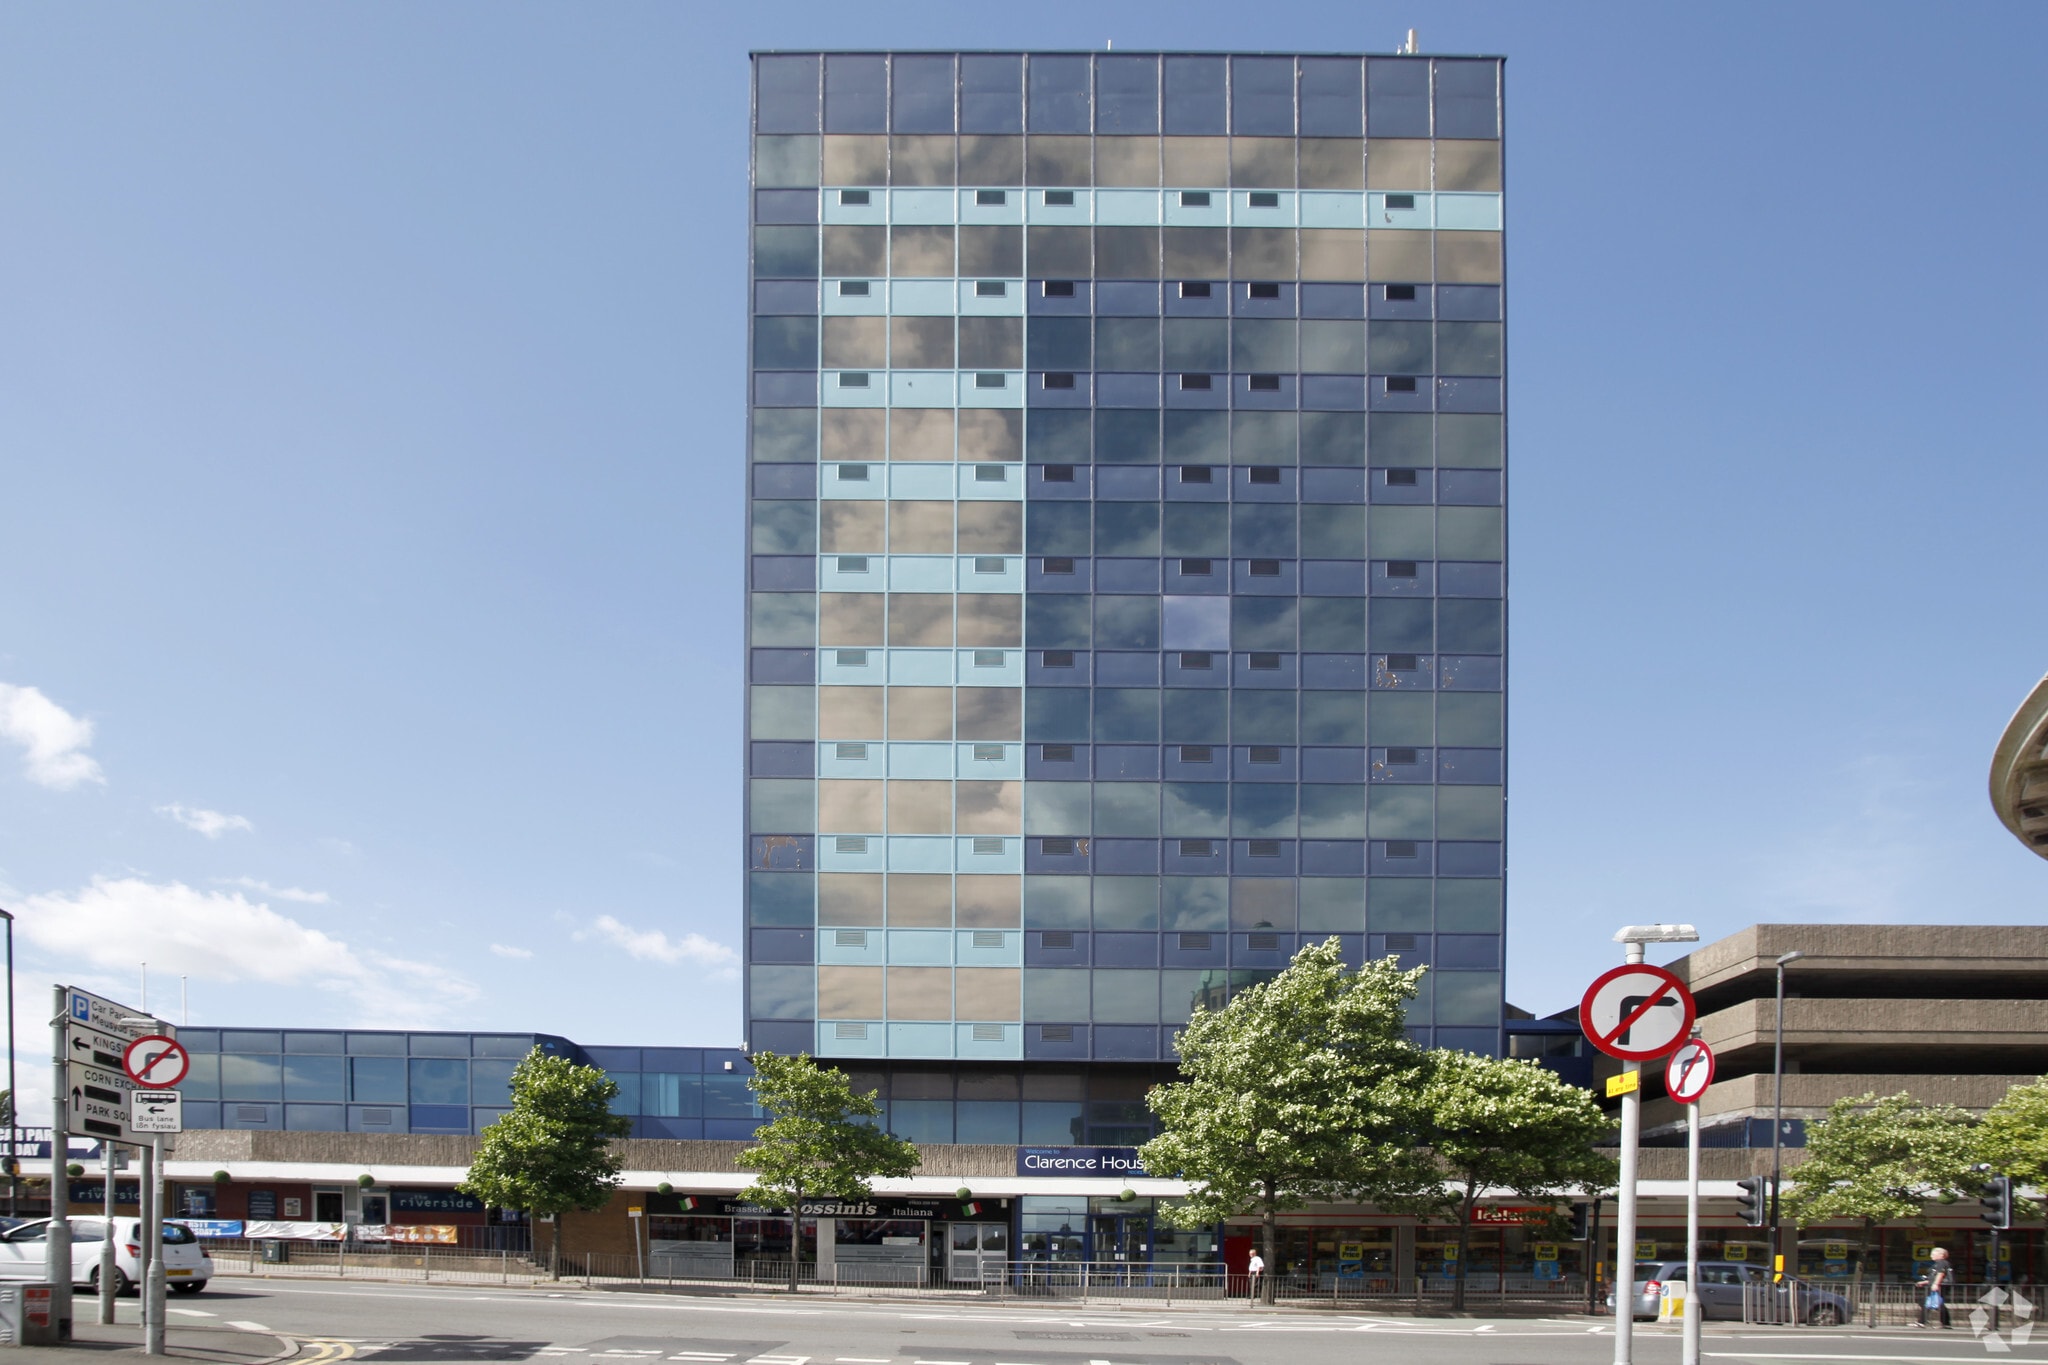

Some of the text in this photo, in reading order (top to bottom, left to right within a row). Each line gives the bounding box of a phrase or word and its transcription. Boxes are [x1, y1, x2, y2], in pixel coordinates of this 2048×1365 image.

[91, 1000, 130, 1019] Car Park
[84, 1070, 112, 1086] CORN
[86, 1104, 131, 1122] PARK SQU
[26, 1129, 52, 1142] PAR
[15, 1143, 40, 1156] DAY
[1025, 1155, 1145, 1170] Clarence Hous
[400, 1198, 473, 1208] riverside
[784, 1201, 877, 1215] ossini's
[892, 1208, 933, 1217] Italiana
[1477, 1210, 1523, 1222] Icela
